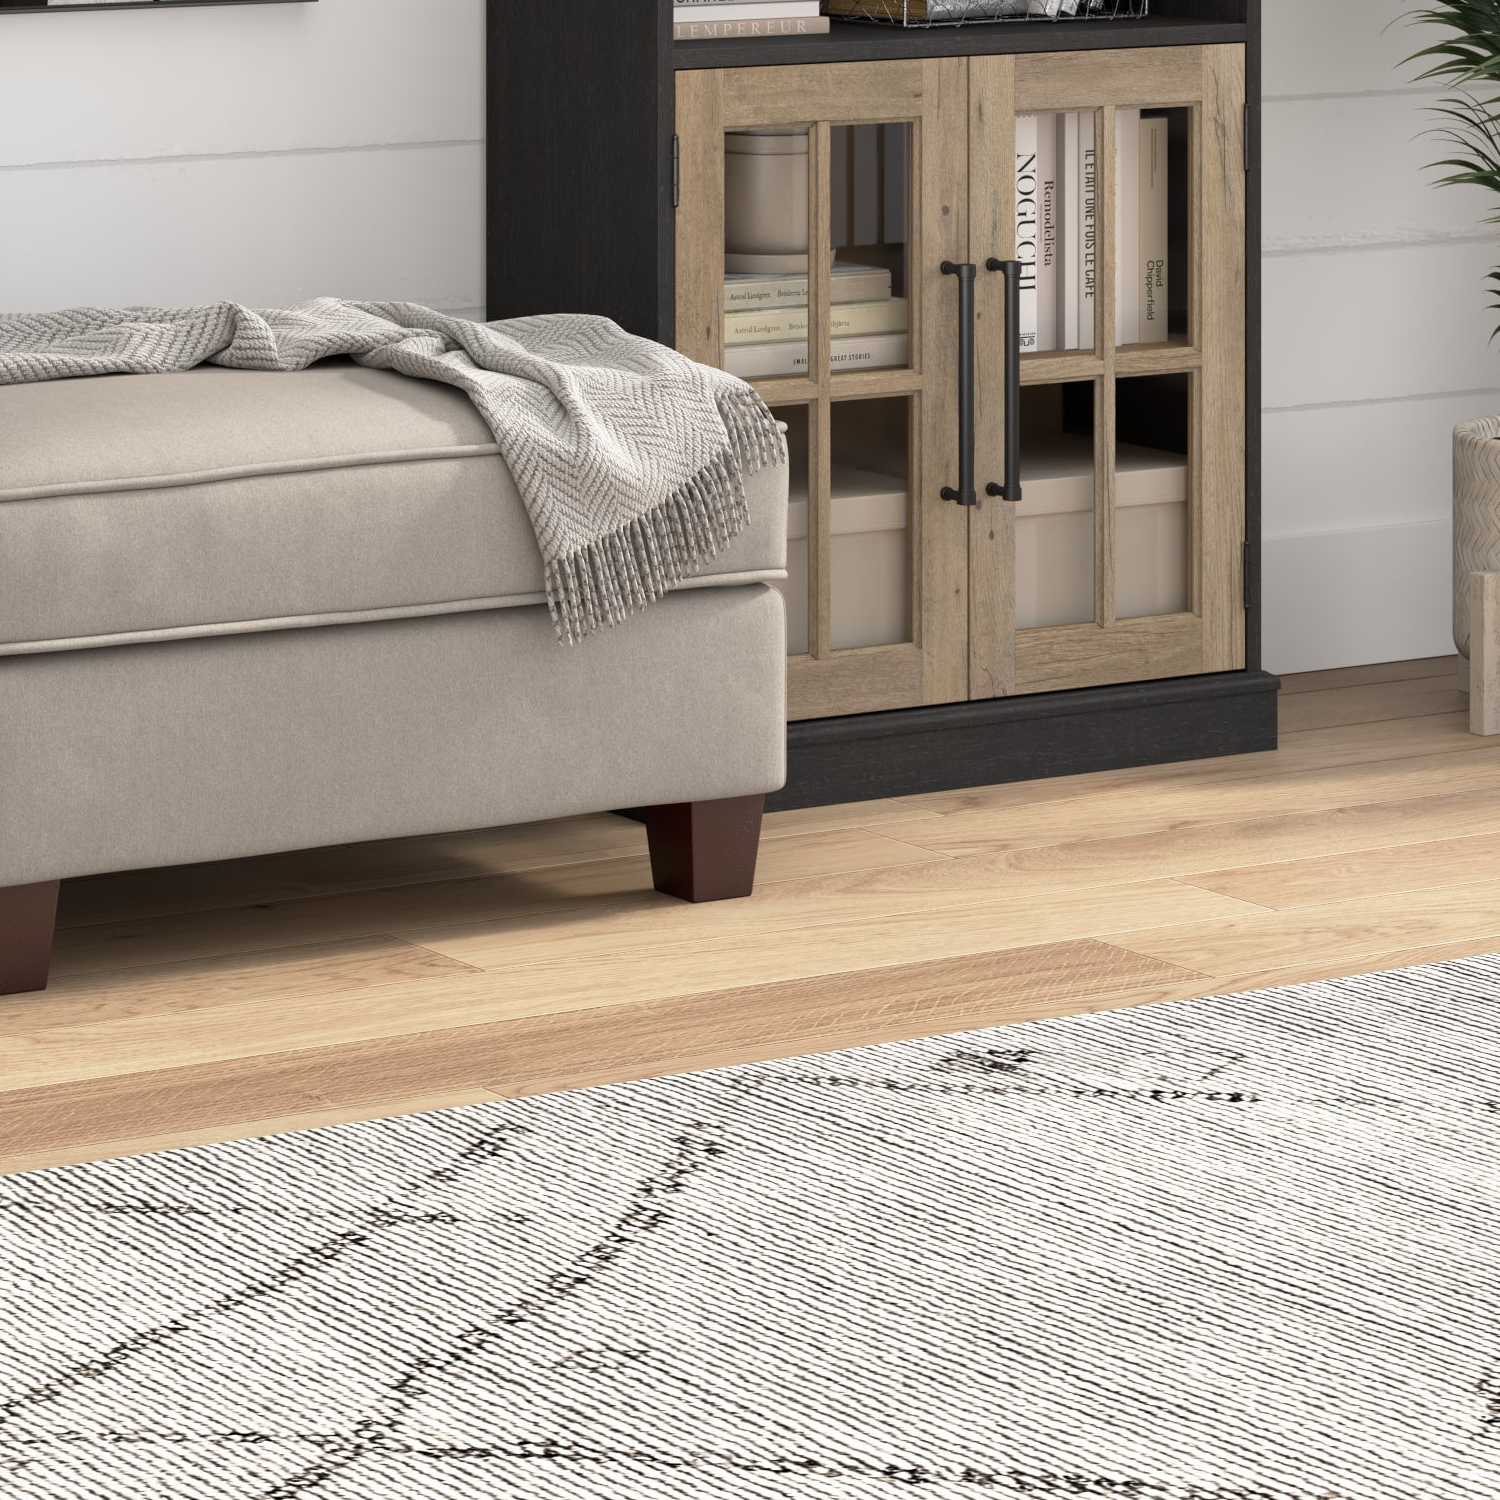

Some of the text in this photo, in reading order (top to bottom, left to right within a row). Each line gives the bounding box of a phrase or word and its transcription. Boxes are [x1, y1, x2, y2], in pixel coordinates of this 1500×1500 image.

[676, 19, 807, 39] LEMPEREUR
[1016, 153, 1037, 290] NOGUCHI
[1043, 180, 1055, 267] Remodelista
[1146, 260, 1155, 321] Chipperfield
[1156, 260, 1164, 287] David
[830, 354, 847, 363] GREAT
[848, 352, 871, 362] STORIES
